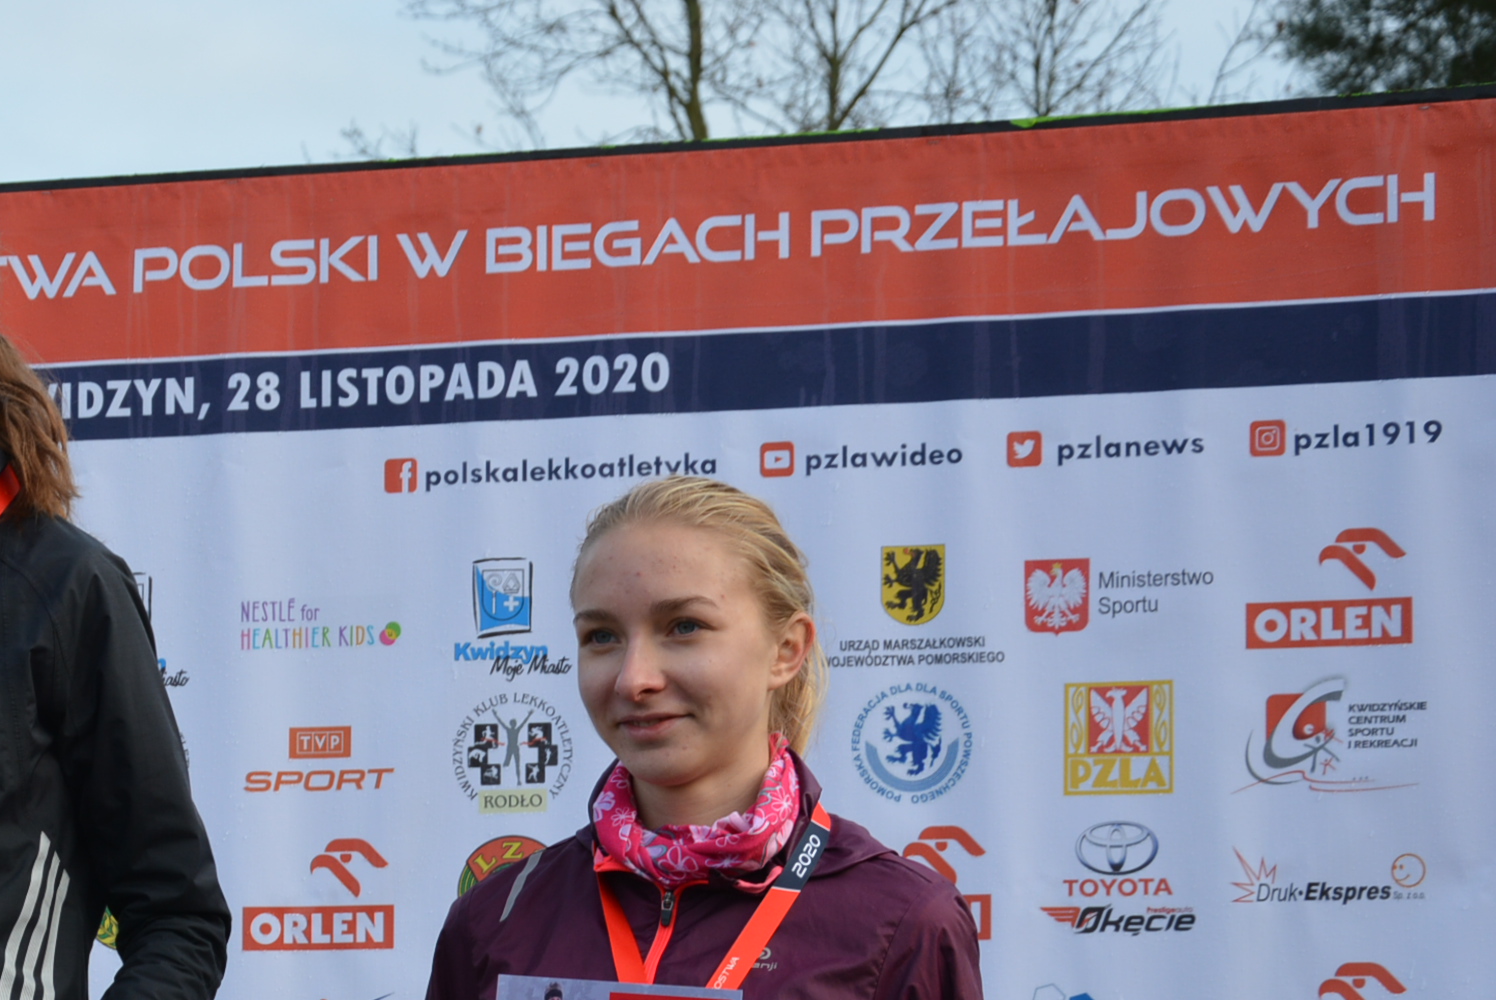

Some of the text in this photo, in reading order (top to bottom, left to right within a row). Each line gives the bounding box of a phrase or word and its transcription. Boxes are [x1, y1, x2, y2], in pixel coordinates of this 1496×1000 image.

[132, 234, 378, 294] POLSKI
[395, 229, 469, 279] W
[484, 211, 791, 275] BIEGACH
[810, 172, 1436, 257] PRZEŁAJOWYCH
[48, 352, 672, 421] IDZYN, 28 LISTOPADA 2020
[1056, 434, 1206, 467] pzlanews
[1292, 420, 1445, 457] pzla1919
[423, 452, 718, 493] polskalekkoatletyka
[804, 443, 964, 477] pzlawideo
[1098, 568, 1215, 589] Ministerstwo
[240, 598, 321, 624] NESTLÉ for
[1098, 596, 1159, 618] Sportu
[1254, 605, 1403, 643] ORLEN
[240, 625, 375, 651] HEALTHIER KIDS
[839, 636, 986, 654] URZĄD MARSZAŁKOWSKI
[454, 641, 548, 664] Kwidzyn
[917, 651, 1006, 666] POMORSKIEGO
[490, 654, 572, 681] Moje Miasto
[473, 693, 508, 717] KLUB
[851, 691, 889, 752] FEDERACJA
[889, 683, 913, 695] DLA
[915, 682, 938, 695] DLA
[938, 690, 971, 729] SPORTU
[1347, 699, 1427, 713] KWIDZYŃSKIE
[1347, 714, 1407, 726] CENTRUM
[1347, 726, 1395, 738] SPORTU
[298, 734, 341, 751] TVP
[1353, 738, 1419, 749] REKREACJI
[243, 768, 395, 793] SPORT
[1070, 757, 1168, 790] PZLA
[484, 794, 543, 809] RODŁO
[790, 833, 822, 879] 2020
[1062, 877, 1173, 897] TOYOTA
[250, 911, 384, 945] ORLEN
